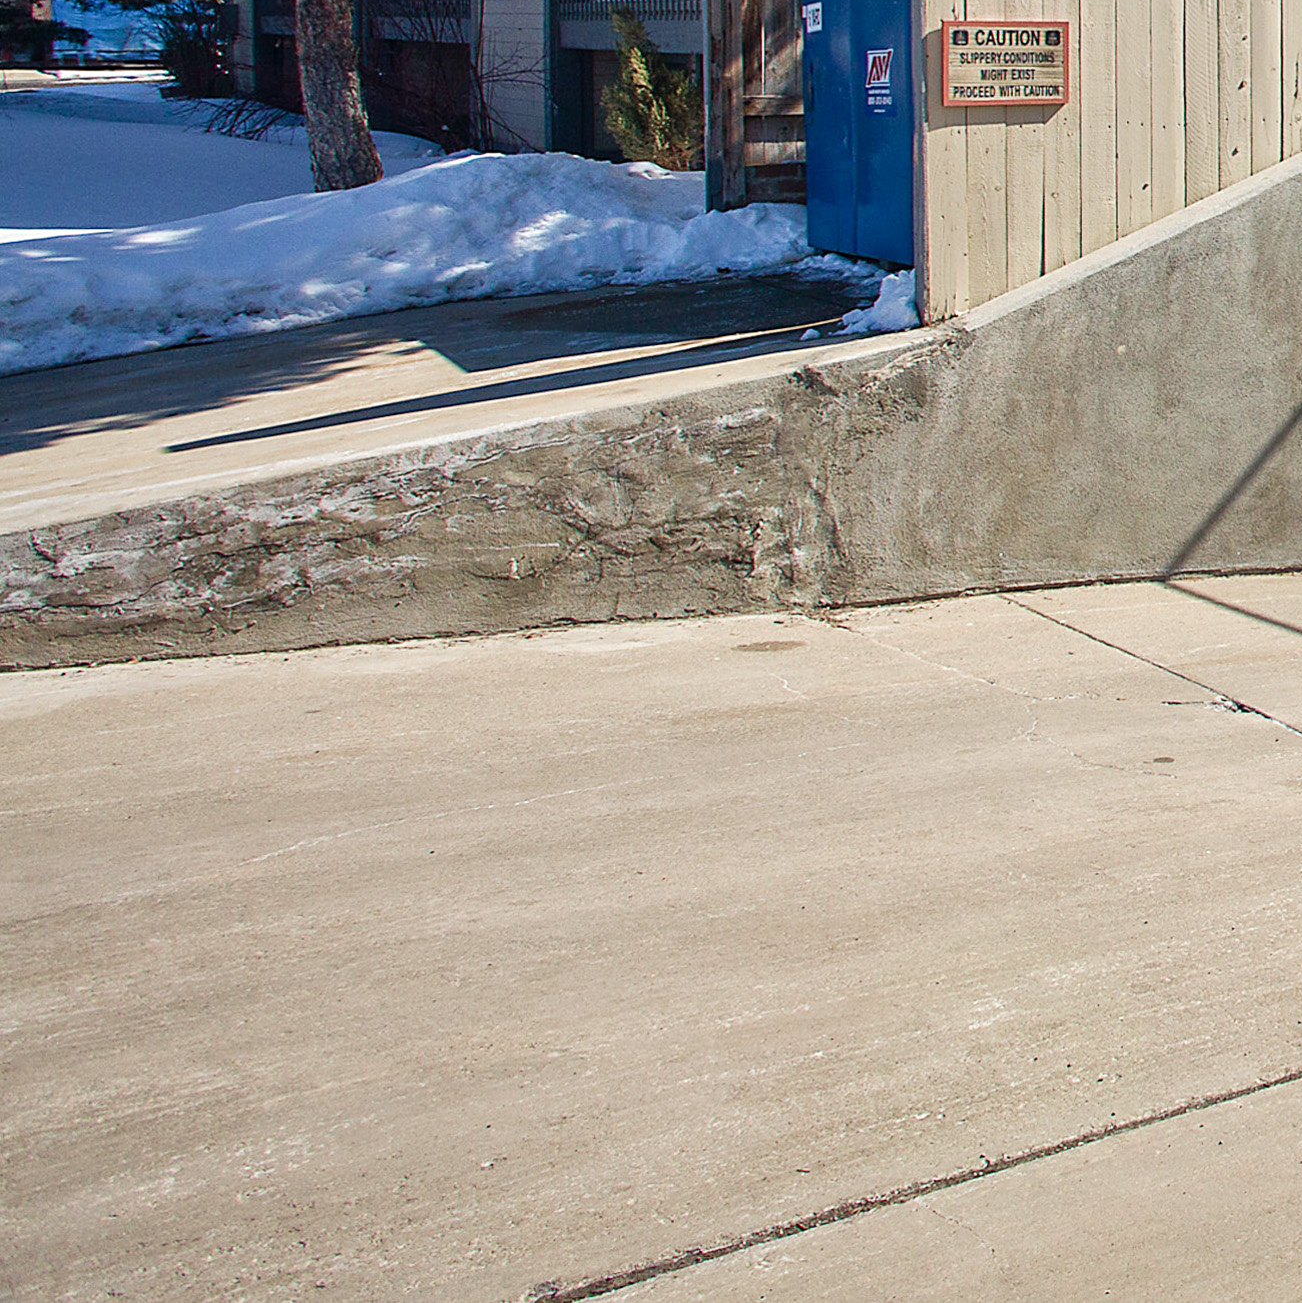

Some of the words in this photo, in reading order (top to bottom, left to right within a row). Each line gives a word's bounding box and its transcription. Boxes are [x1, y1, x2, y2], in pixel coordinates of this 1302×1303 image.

[975, 29, 1040, 46] CAUTION
[960, 52, 1001, 64] SLIPPERY
[1003, 51, 1055, 64] CONDITIONS
[980, 69, 1008, 81] MIGHT
[1011, 69, 1036, 80] EXIST
[953, 85, 996, 98] PROCEED
[999, 85, 1020, 97] WITH
[1023, 85, 1060, 97] CAUTION
